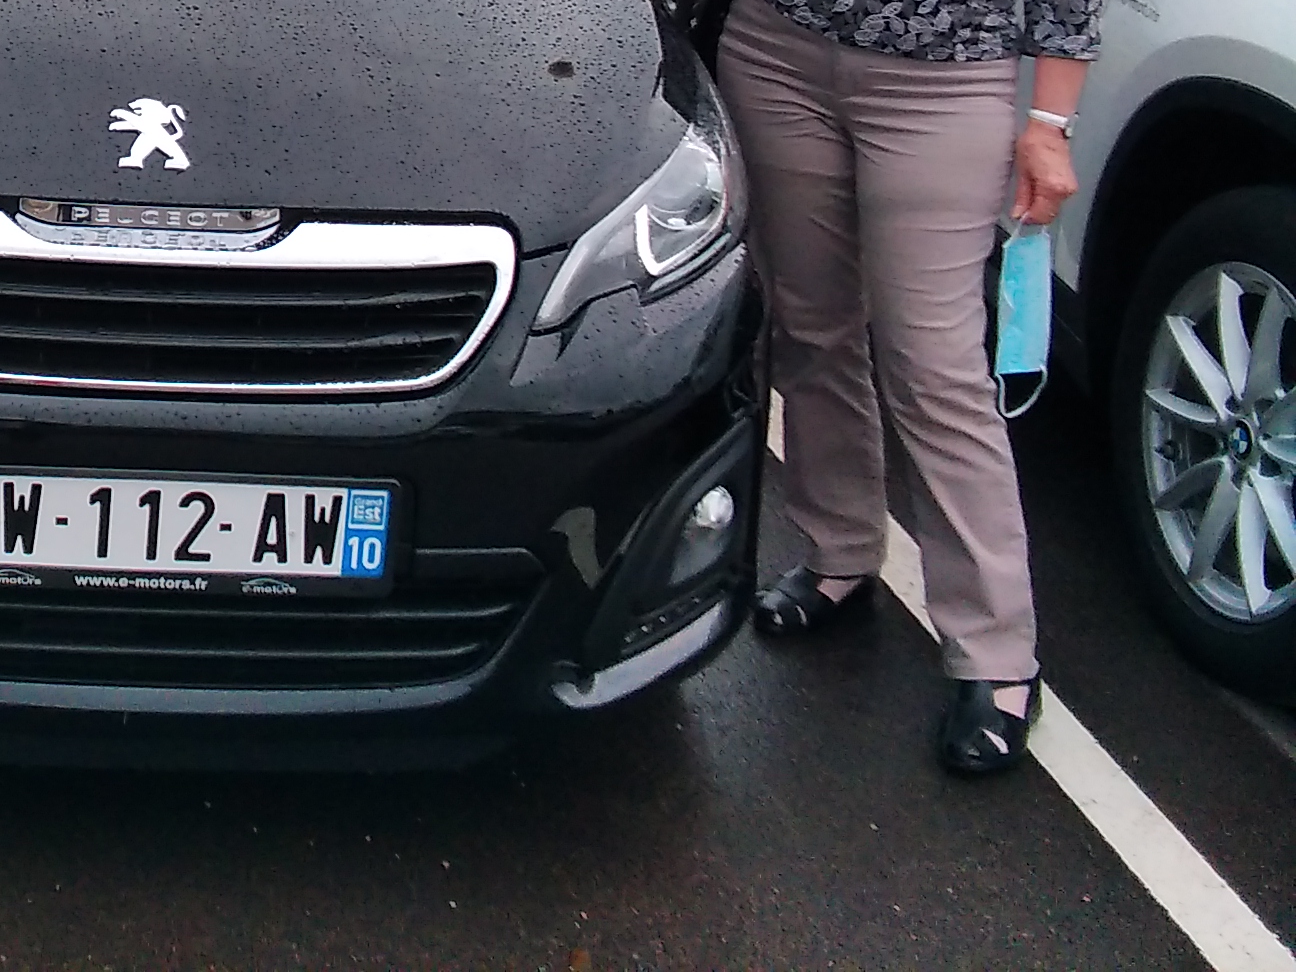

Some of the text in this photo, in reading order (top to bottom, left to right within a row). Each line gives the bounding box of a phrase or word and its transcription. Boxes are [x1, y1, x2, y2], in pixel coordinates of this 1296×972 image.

[353, 505, 382, 521] Est
[347, 535, 383, 570] 10
[74, 574, 208, 592] www.e-motors.fr
